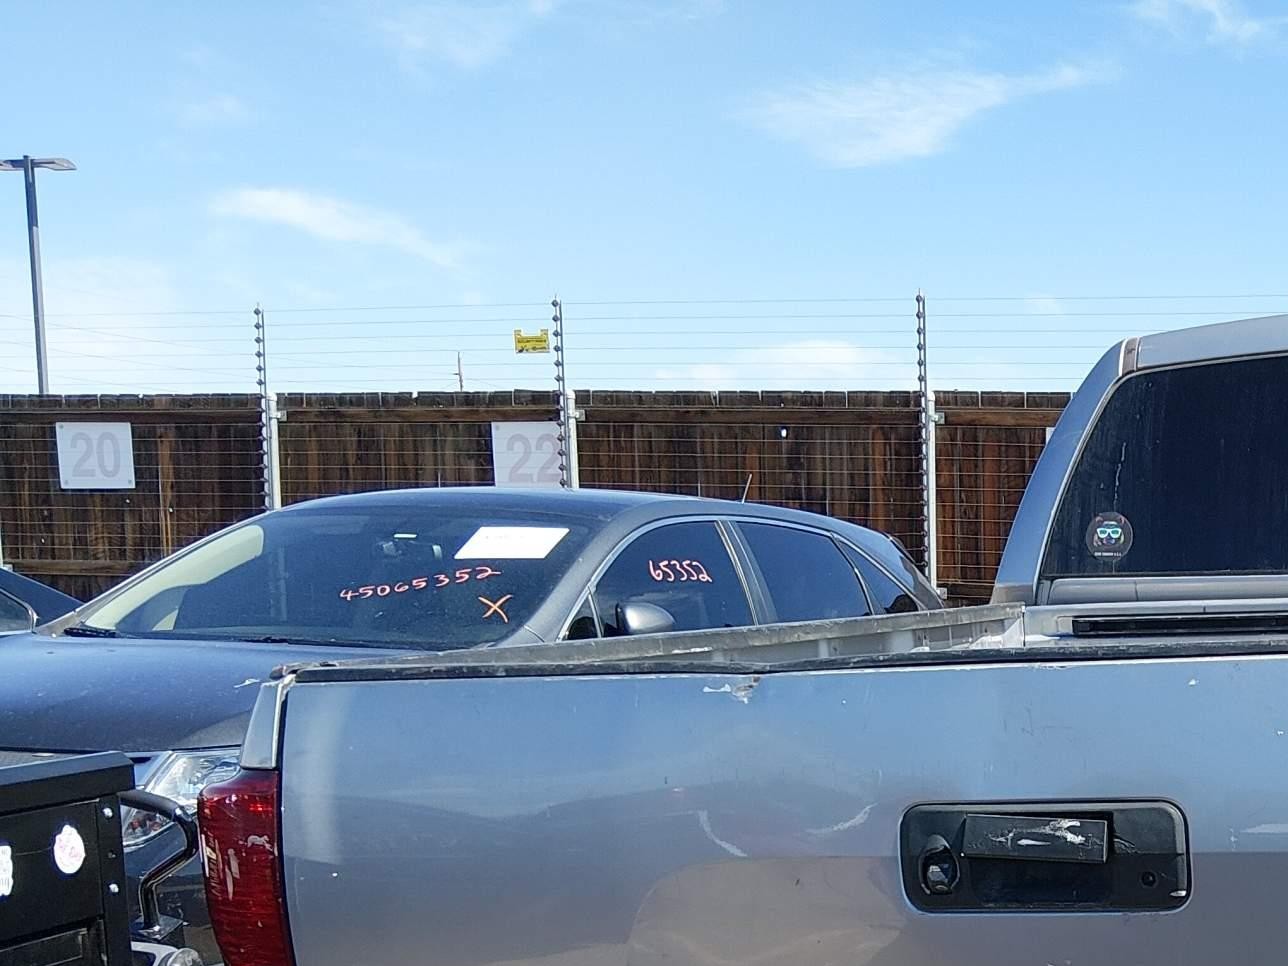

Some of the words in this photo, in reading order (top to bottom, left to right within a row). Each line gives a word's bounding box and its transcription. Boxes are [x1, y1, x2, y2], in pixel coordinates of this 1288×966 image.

[70, 431, 121, 478] 20
[506, 432, 562, 483] 22
[339, 566, 502, 601] 45065352
[648, 559, 713, 583] 65352
